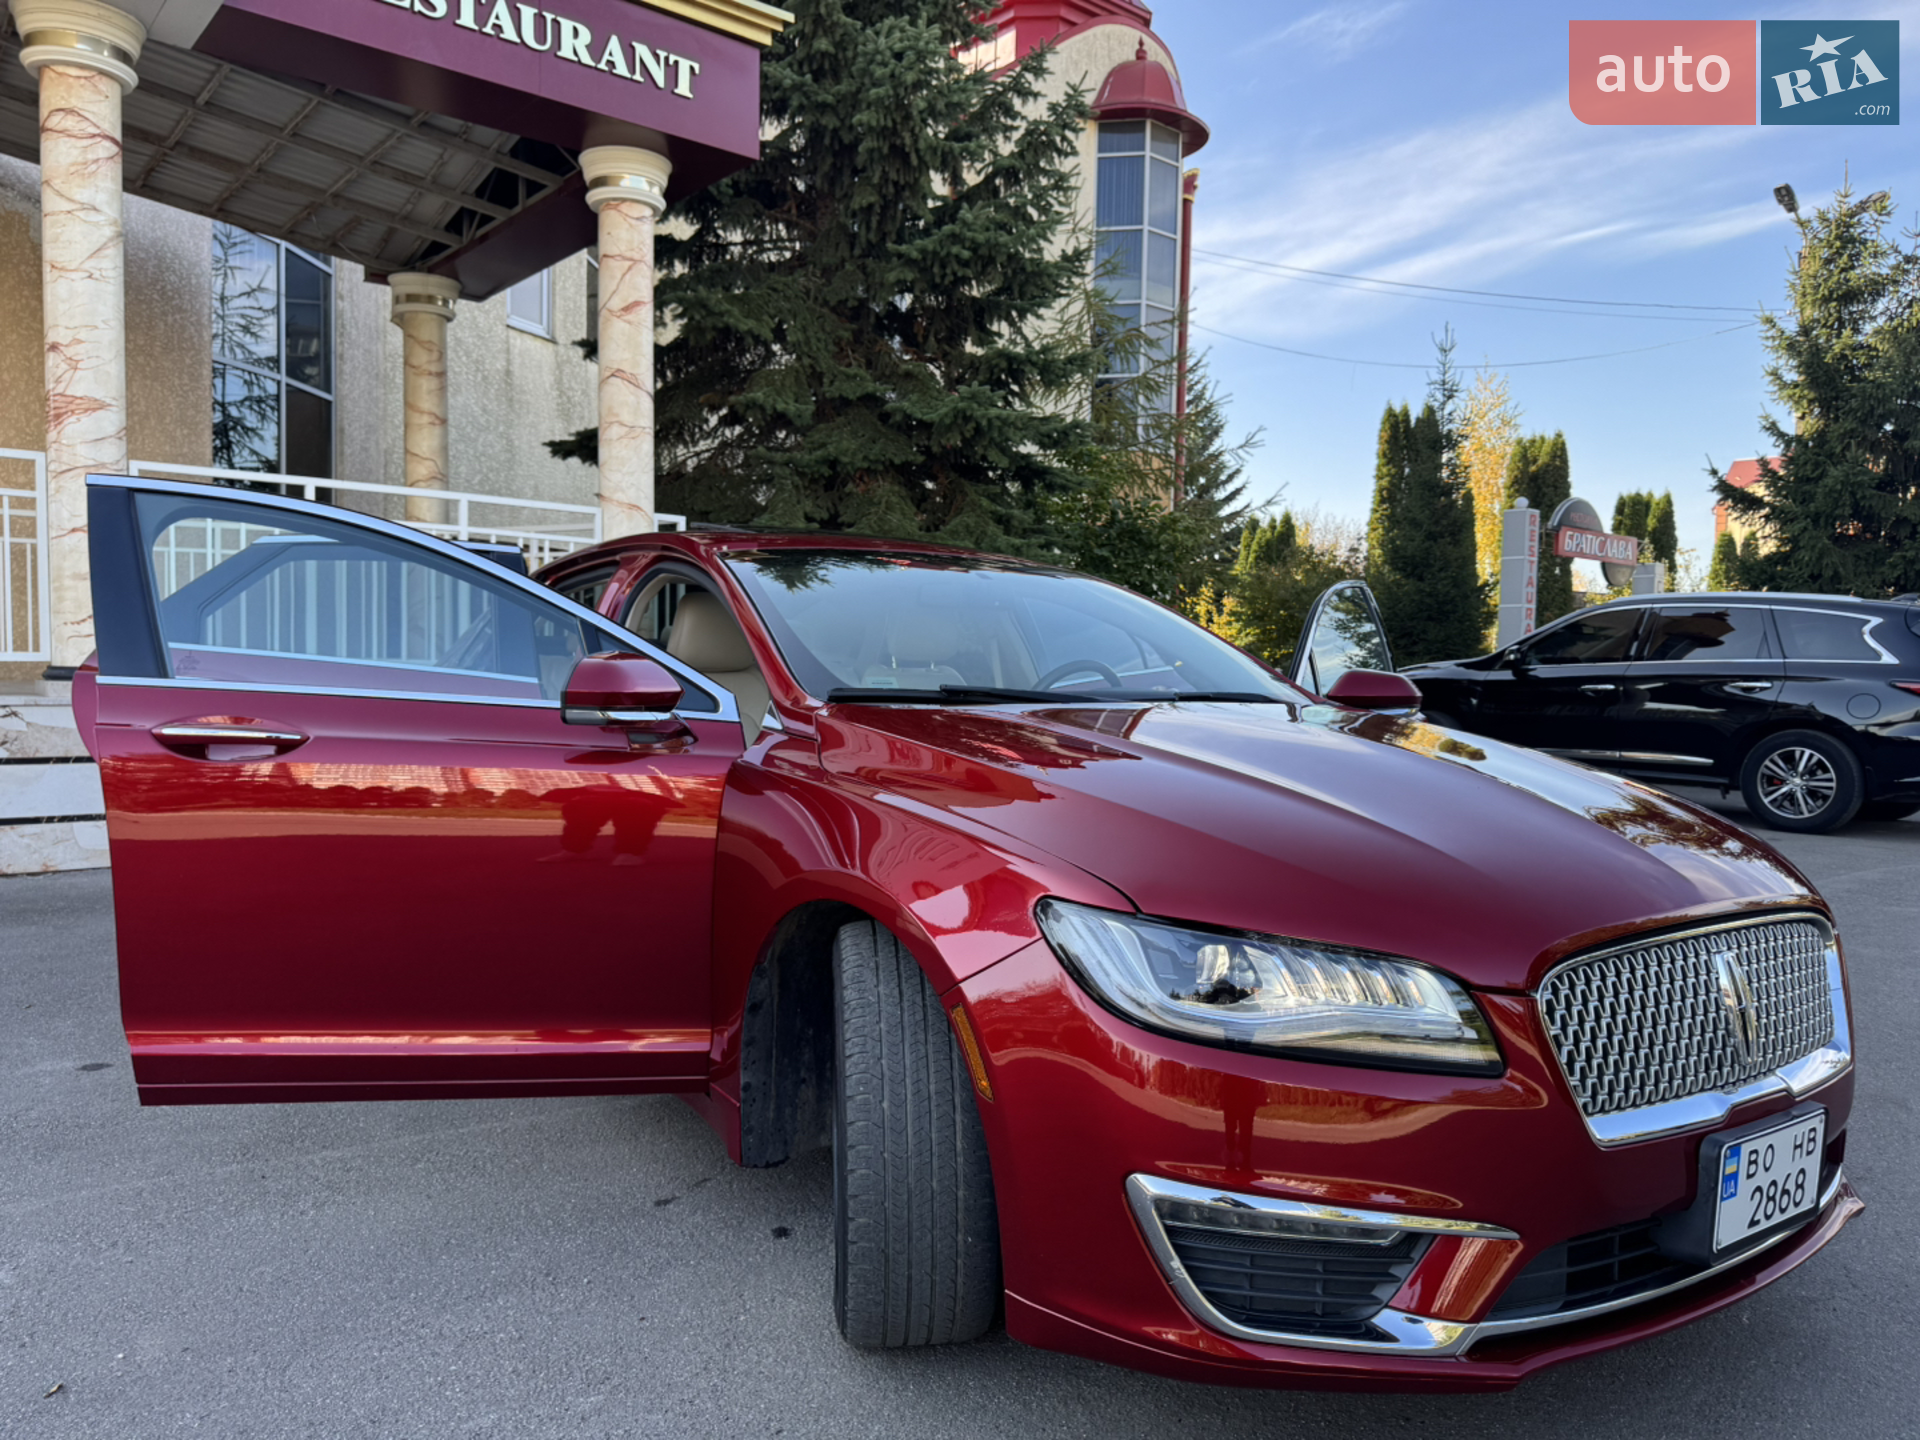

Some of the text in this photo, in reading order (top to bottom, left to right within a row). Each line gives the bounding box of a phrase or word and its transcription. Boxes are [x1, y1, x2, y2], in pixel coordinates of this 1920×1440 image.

[374, 0, 700, 98] TAURANT
[1746, 1126, 1817, 1180] BO HB
[1722, 1180, 1736, 1198] UA
[1747, 1167, 1806, 1230] 2868
